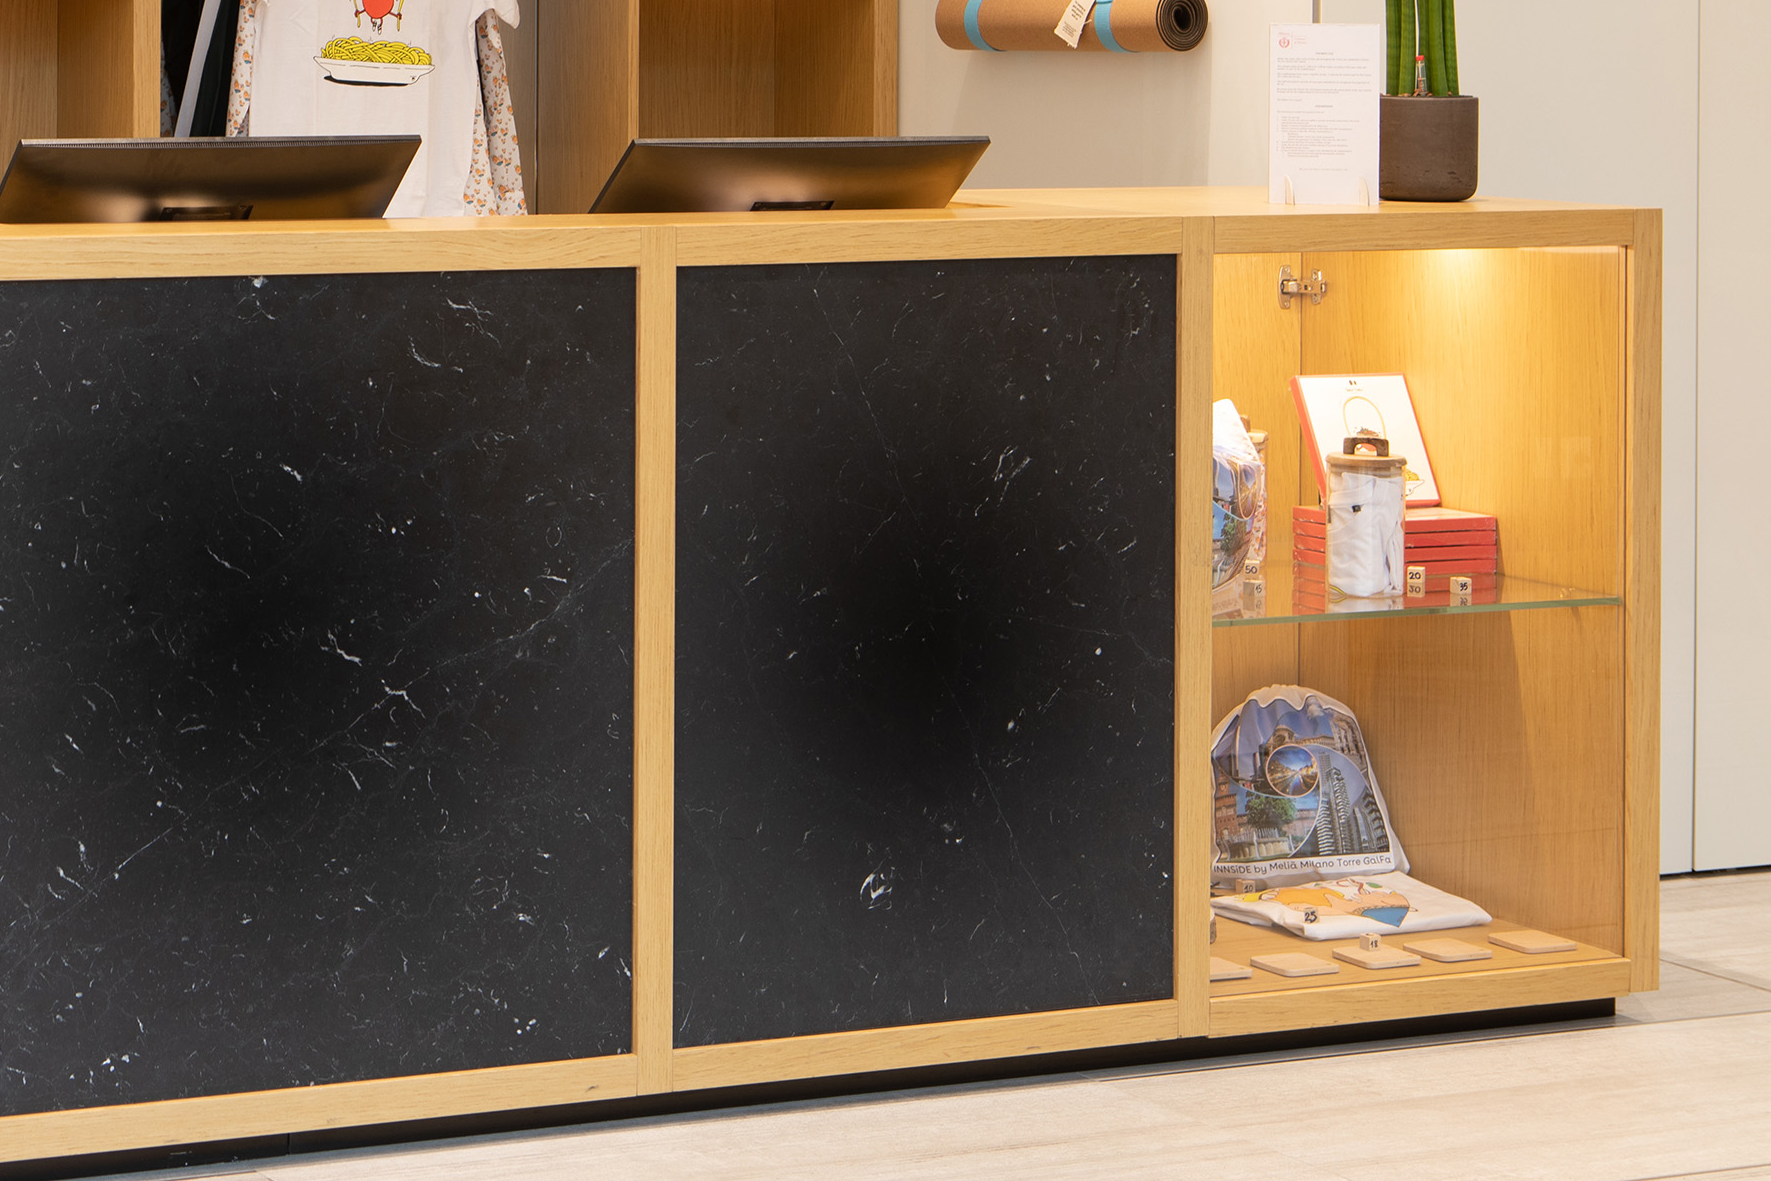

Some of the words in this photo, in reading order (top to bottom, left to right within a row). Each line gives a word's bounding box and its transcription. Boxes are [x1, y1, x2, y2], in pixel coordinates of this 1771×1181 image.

[1244, 564, 1258, 574] 50
[1408, 571, 1421, 580] 20
[1459, 582, 1468, 591] 35
[1254, 865, 1267, 875] by
[1300, 859, 1334, 869] Milano
[1336, 858, 1361, 867] Torre
[1363, 855, 1392, 865] GalFa
[1244, 884, 1254, 893] 10
[1304, 911, 1317, 923] 25
[1370, 939, 1378, 948] 18
